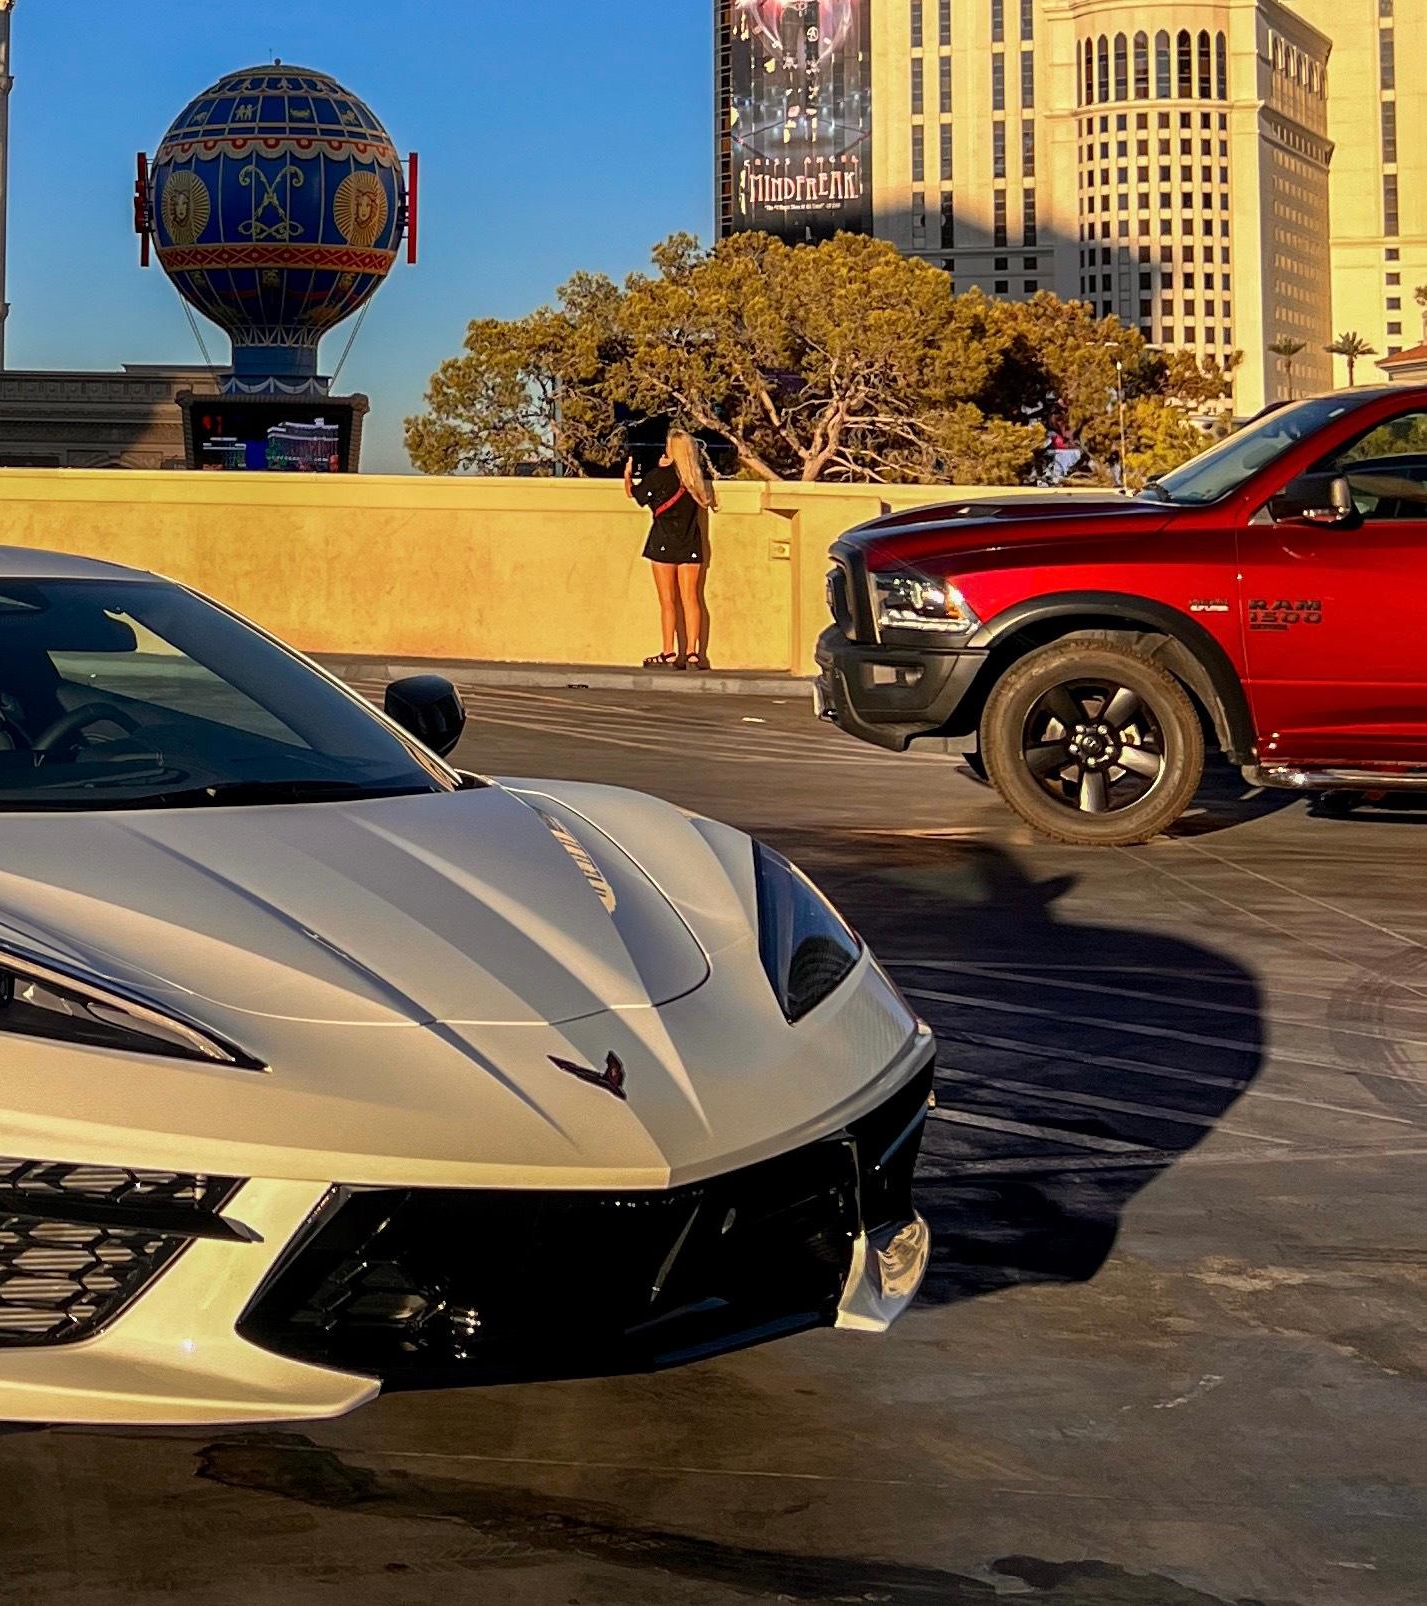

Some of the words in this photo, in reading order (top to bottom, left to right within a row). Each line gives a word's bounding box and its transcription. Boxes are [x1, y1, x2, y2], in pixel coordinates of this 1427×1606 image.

[749, 171, 858, 202] MINDFREAK
[1249, 600, 1321, 610] RAM
[1249, 612, 1321, 624] 1500
